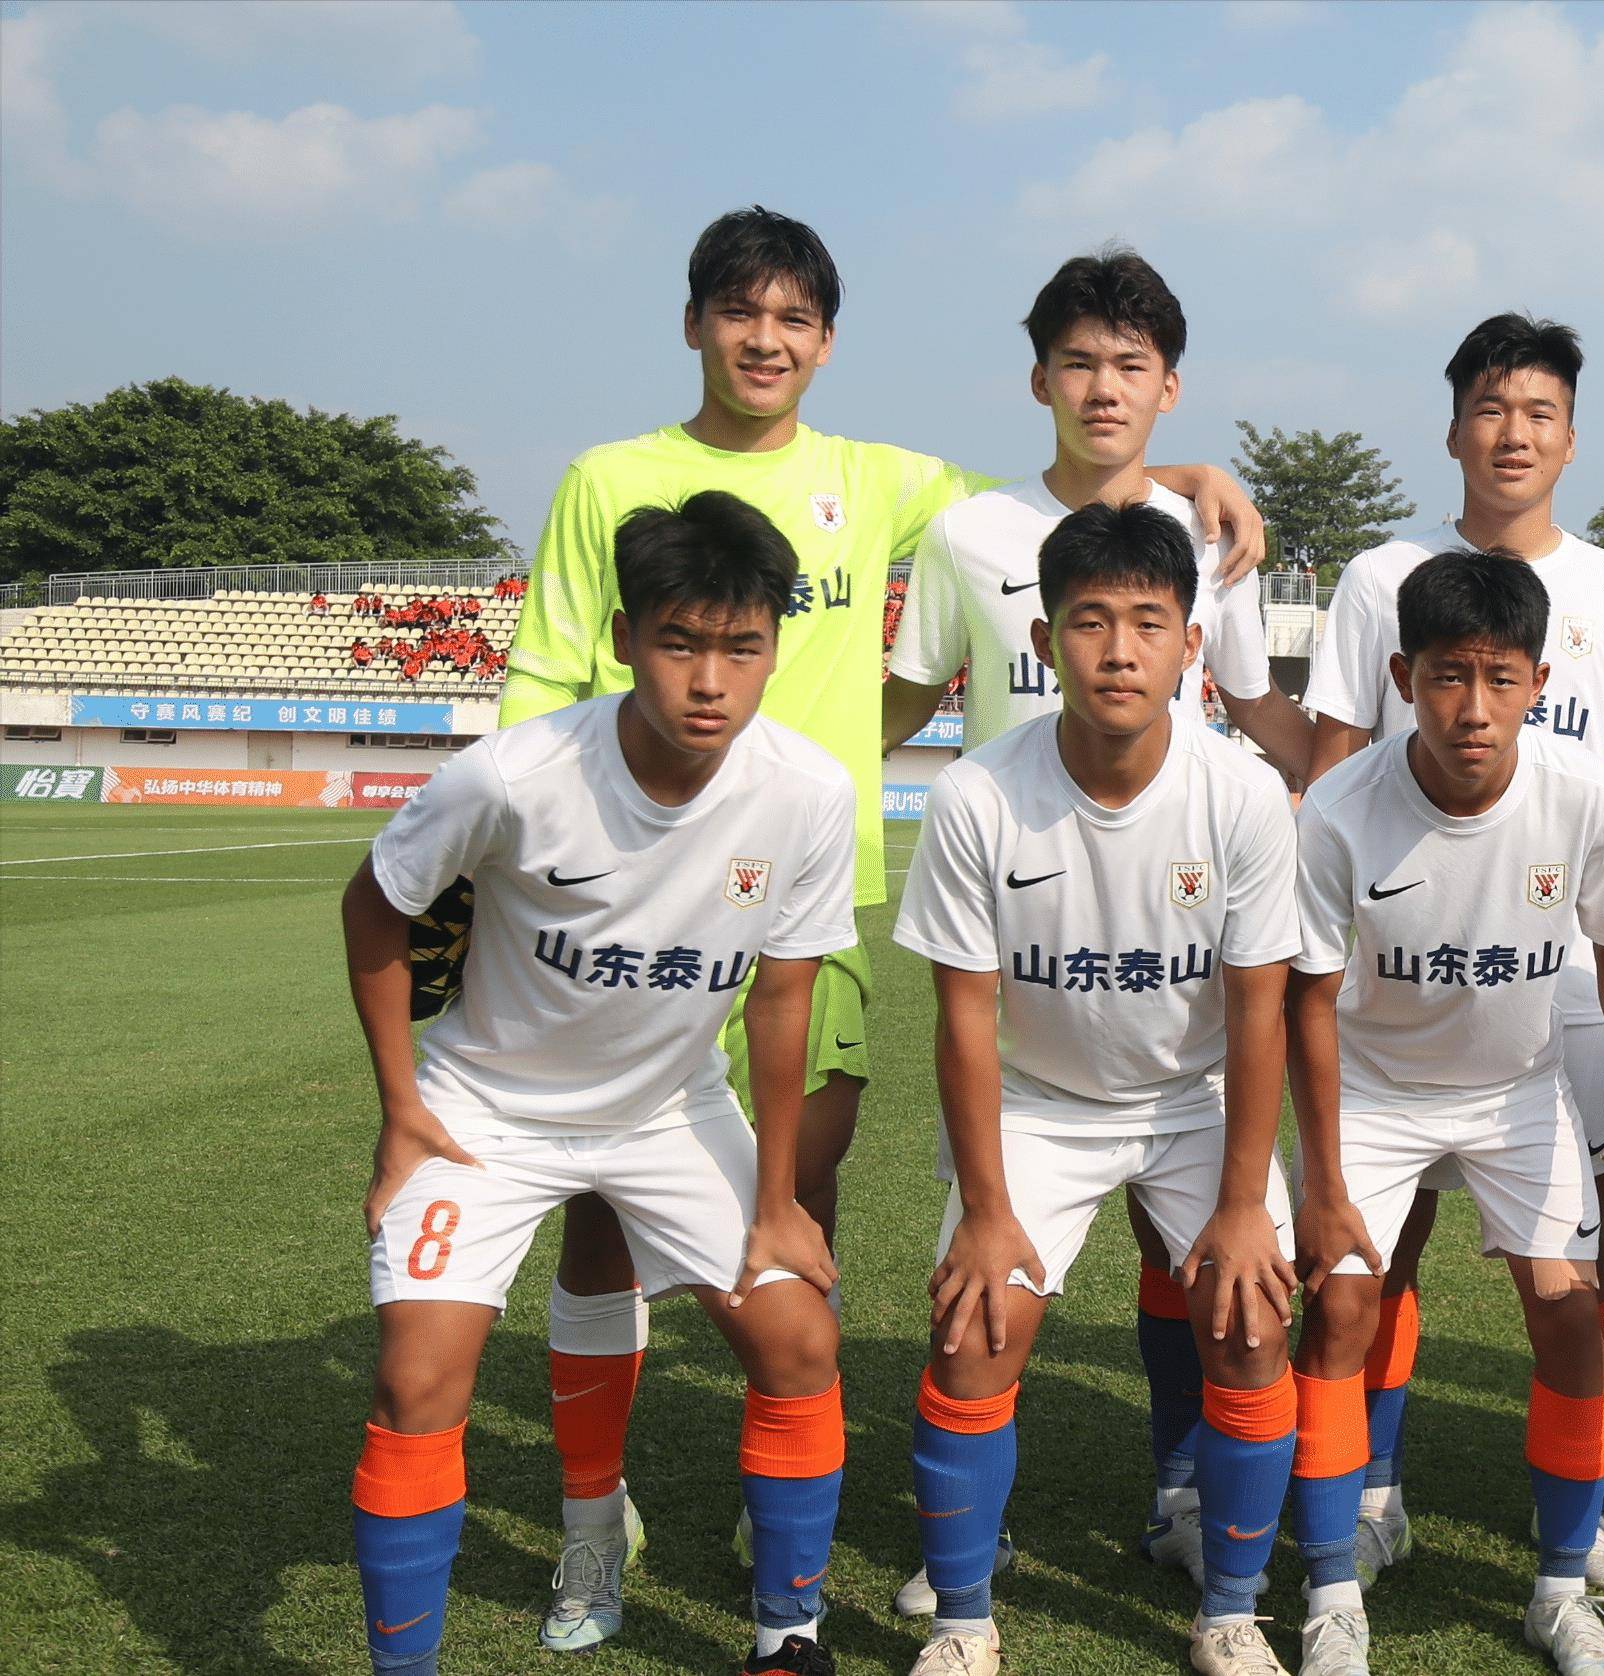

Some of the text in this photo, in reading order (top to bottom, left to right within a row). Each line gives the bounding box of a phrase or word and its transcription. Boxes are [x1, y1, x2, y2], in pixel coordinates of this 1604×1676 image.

[131, 702, 397, 726] 守赛风赛纪 创文明佳绩
[15, 768, 95, 798] 怡寶
[144, 779, 282, 797] 弘扬中华体育精神
[534, 929, 757, 993] 山东泰山
[1013, 943, 1213, 993] 山东泰山
[1377, 940, 1566, 987] 山东泰山
[408, 1200, 461, 1280] 8
